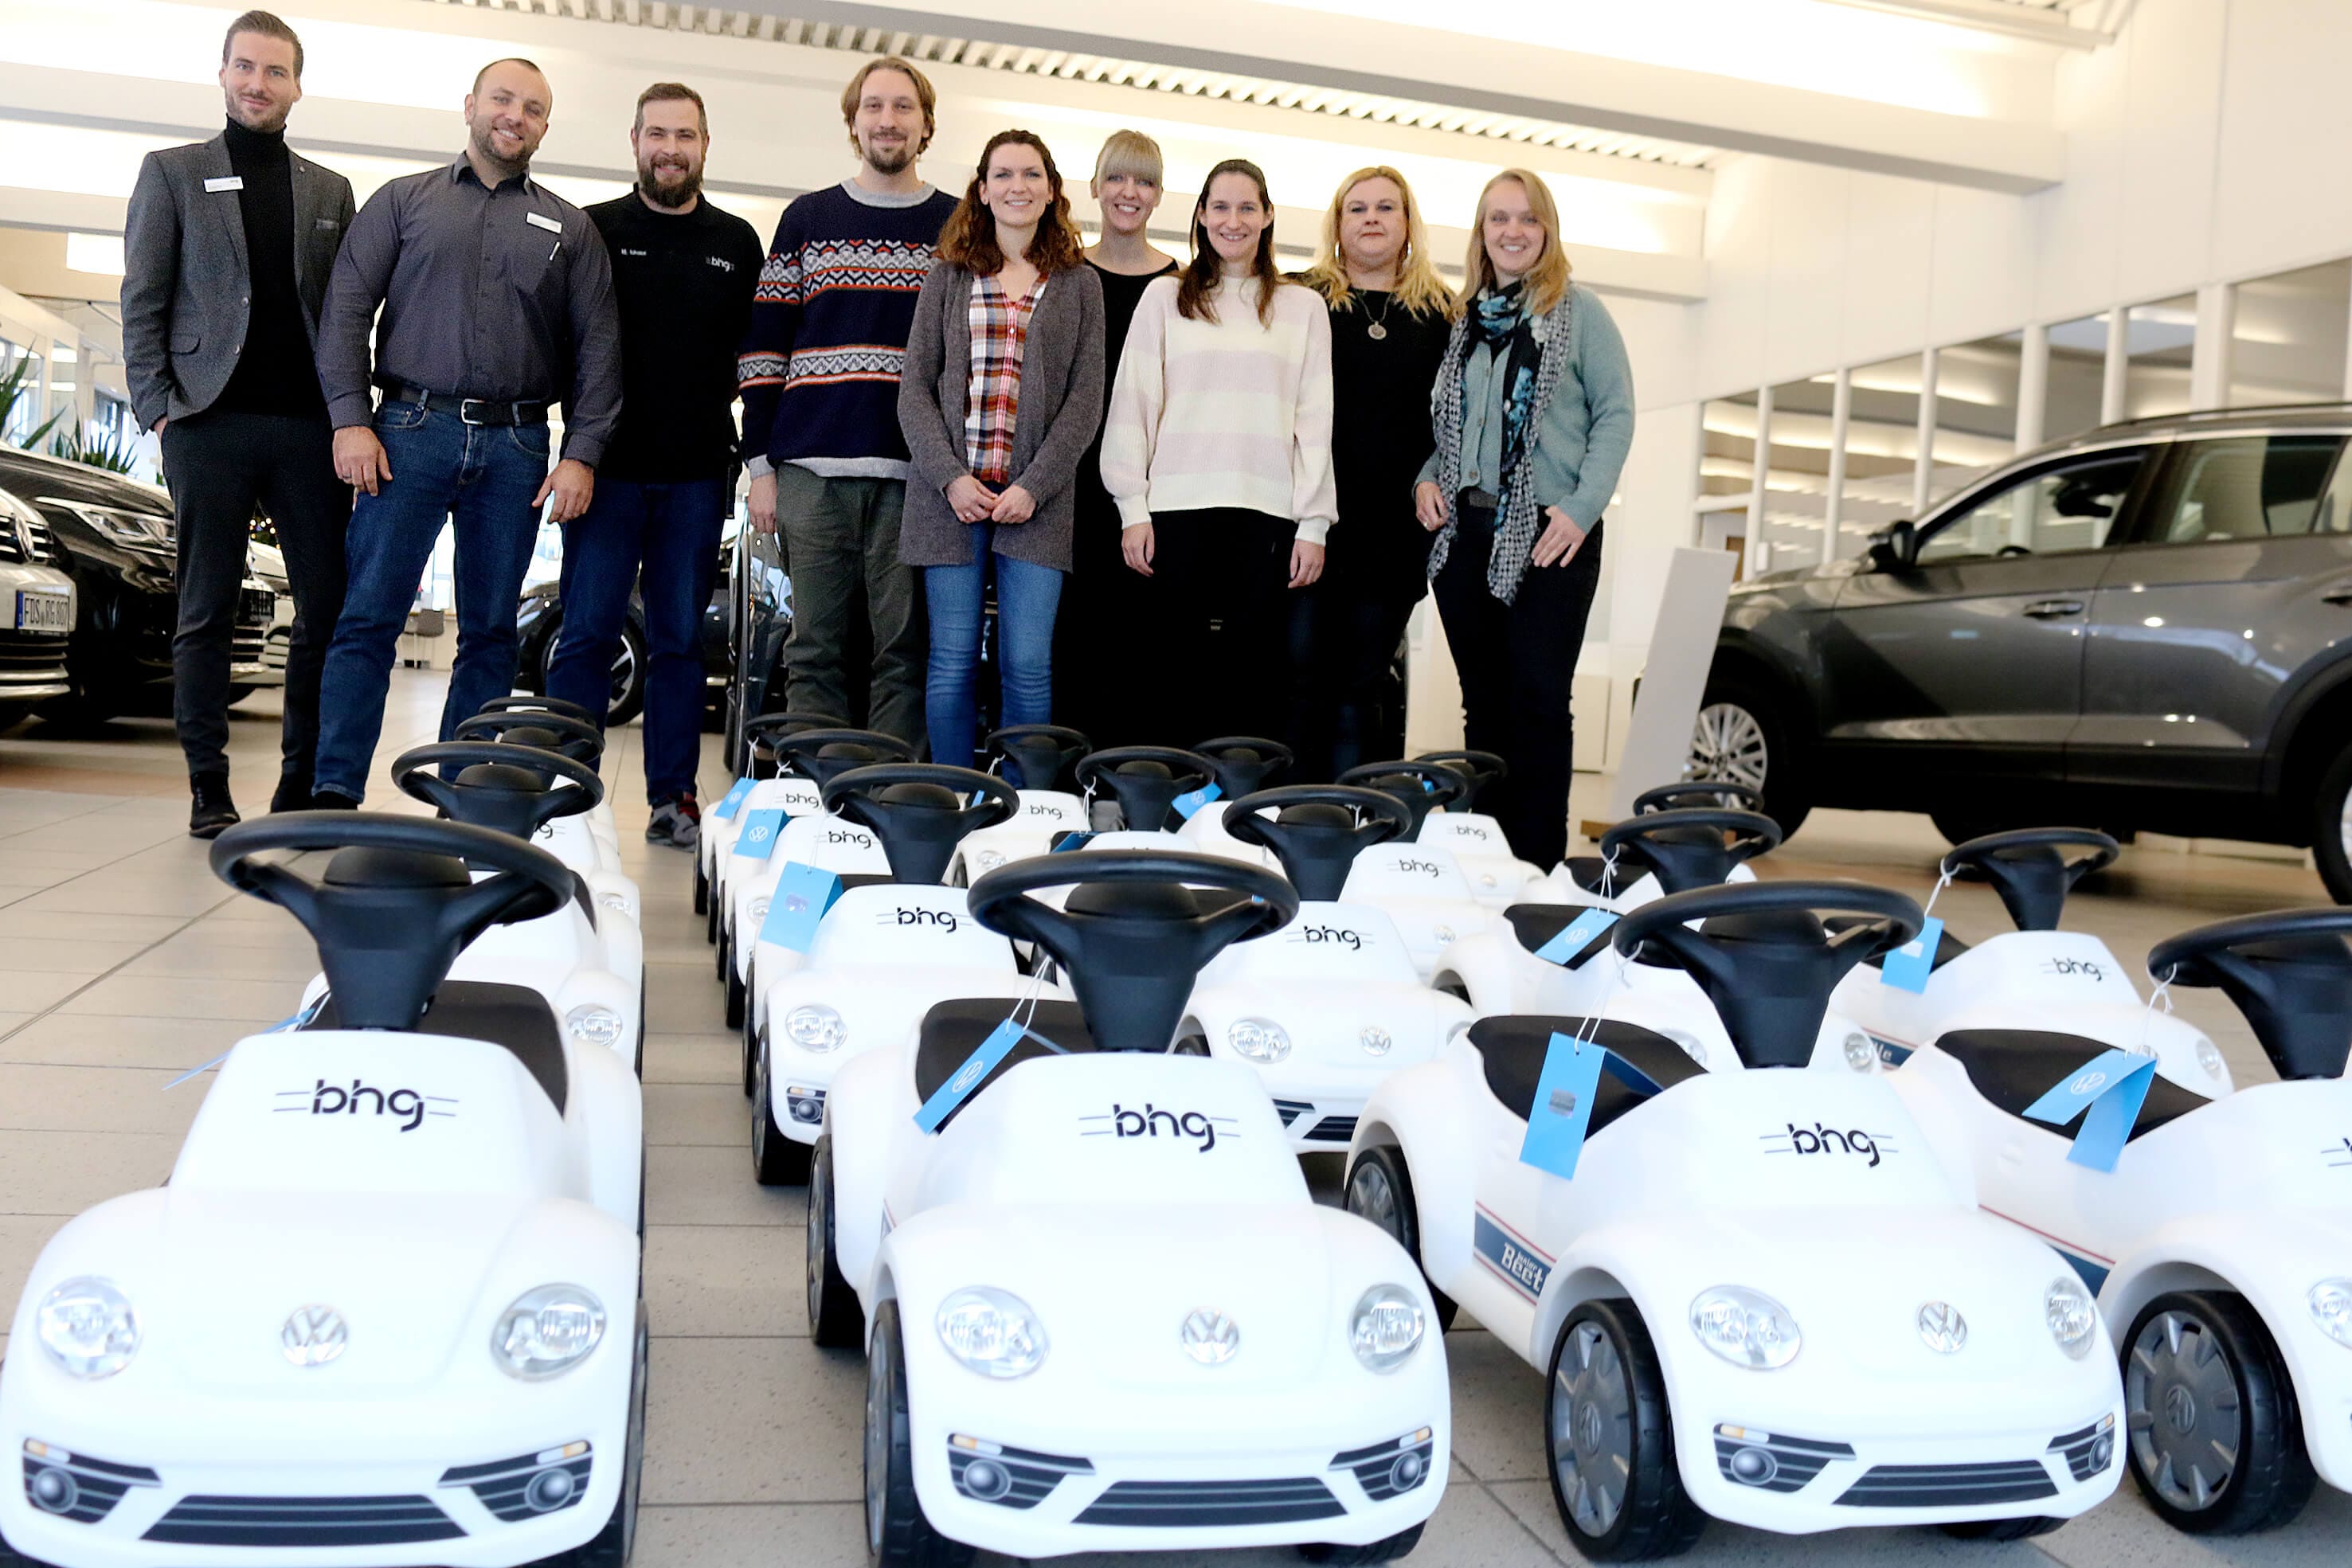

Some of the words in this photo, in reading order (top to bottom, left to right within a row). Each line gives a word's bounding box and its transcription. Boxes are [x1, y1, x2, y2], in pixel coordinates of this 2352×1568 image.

[785, 793, 820, 808] bhg
[1030, 805, 1063, 819] bhg
[828, 831, 871, 849] bhg
[1456, 825, 1487, 840] bhg
[1399, 859, 1439, 878] bhg
[897, 906, 957, 933] bhg
[1303, 925, 1361, 951] bhg
[2053, 957, 2103, 982] bhg
[311, 1079, 425, 1132] bhg
[1112, 1103, 1216, 1154] bhg
[1787, 1122, 1880, 1168] bhg
[1501, 1241, 1544, 1292] Beet
